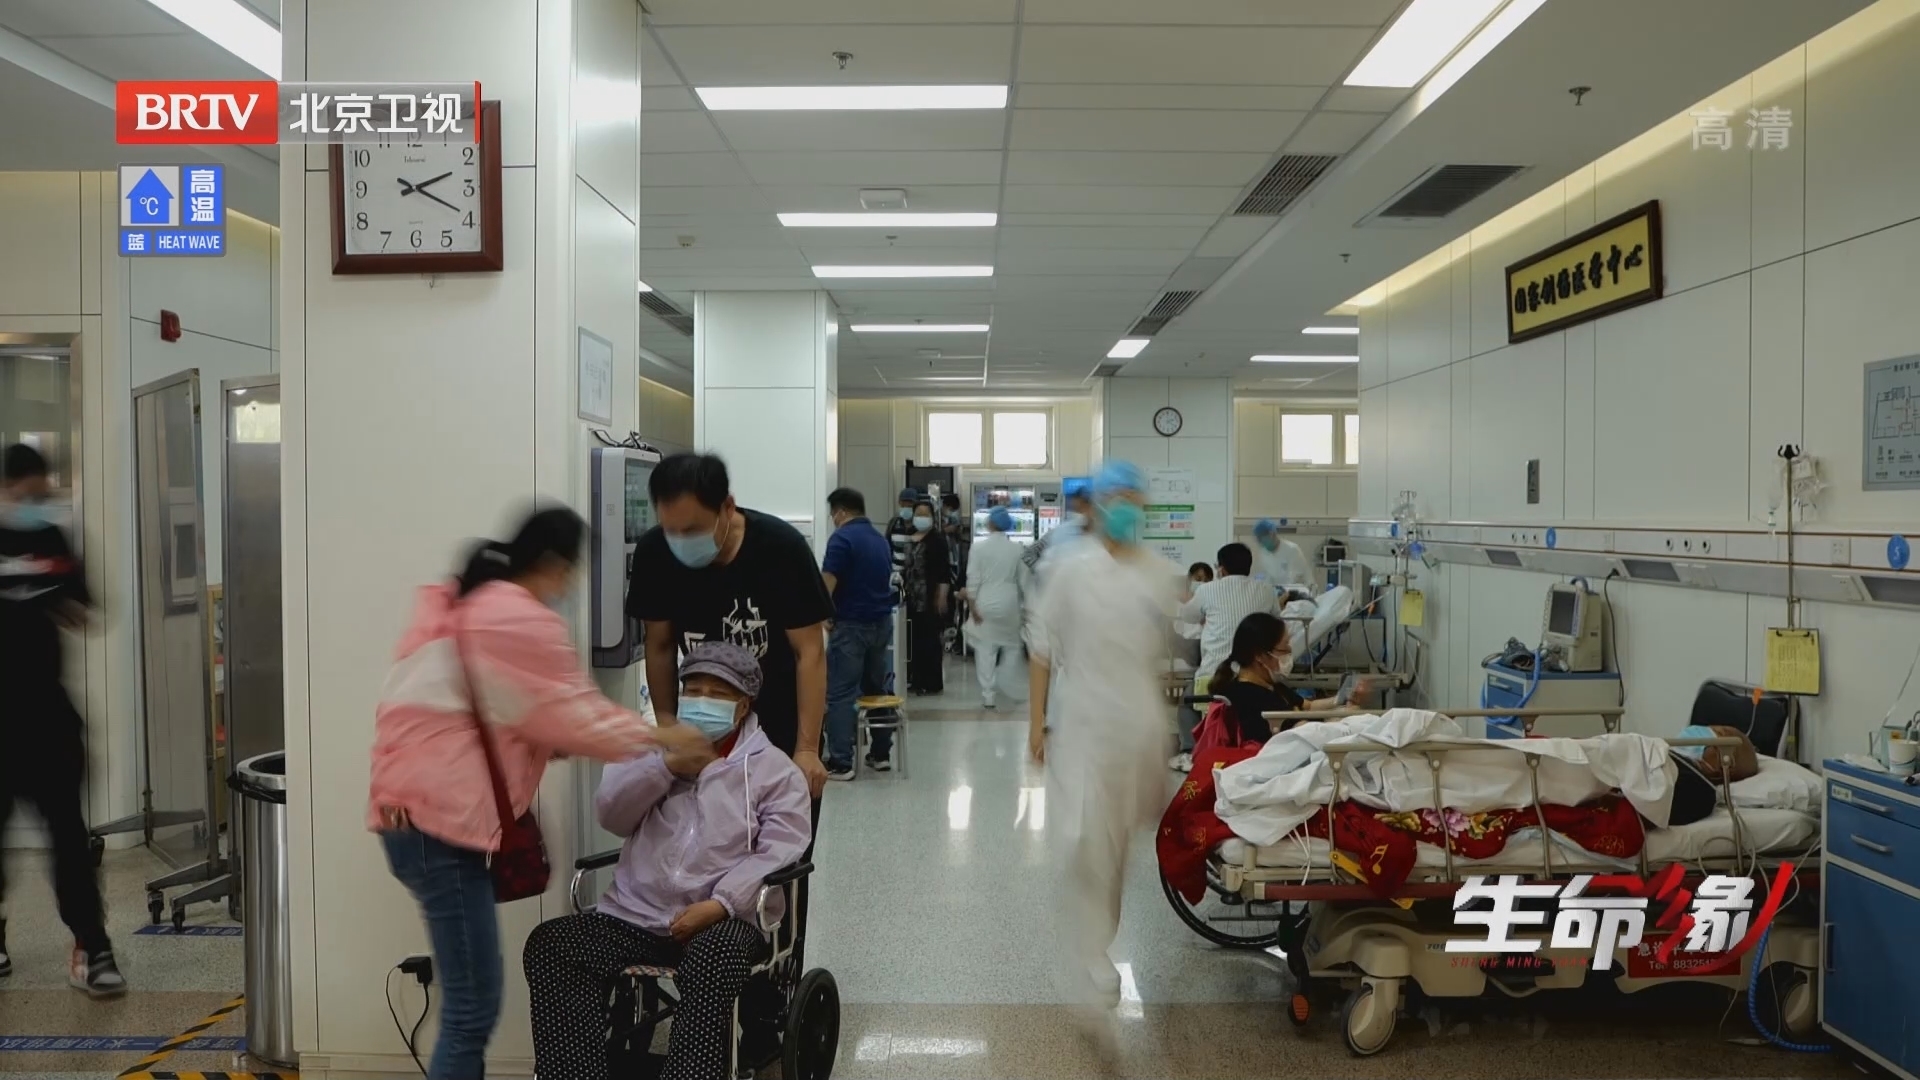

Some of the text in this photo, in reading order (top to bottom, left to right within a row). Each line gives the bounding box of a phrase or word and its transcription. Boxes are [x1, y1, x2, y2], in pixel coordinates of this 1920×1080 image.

[353, 149, 370, 167] 10
[462, 147, 474, 165] 2
[355, 180, 368, 199] 9
[463, 179, 475, 197] 3
[356, 212, 369, 231] 8
[461, 211, 476, 229] 4
[380, 230, 392, 249] 7
[410, 230, 422, 248] 6
[440, 230, 453, 248] 5
